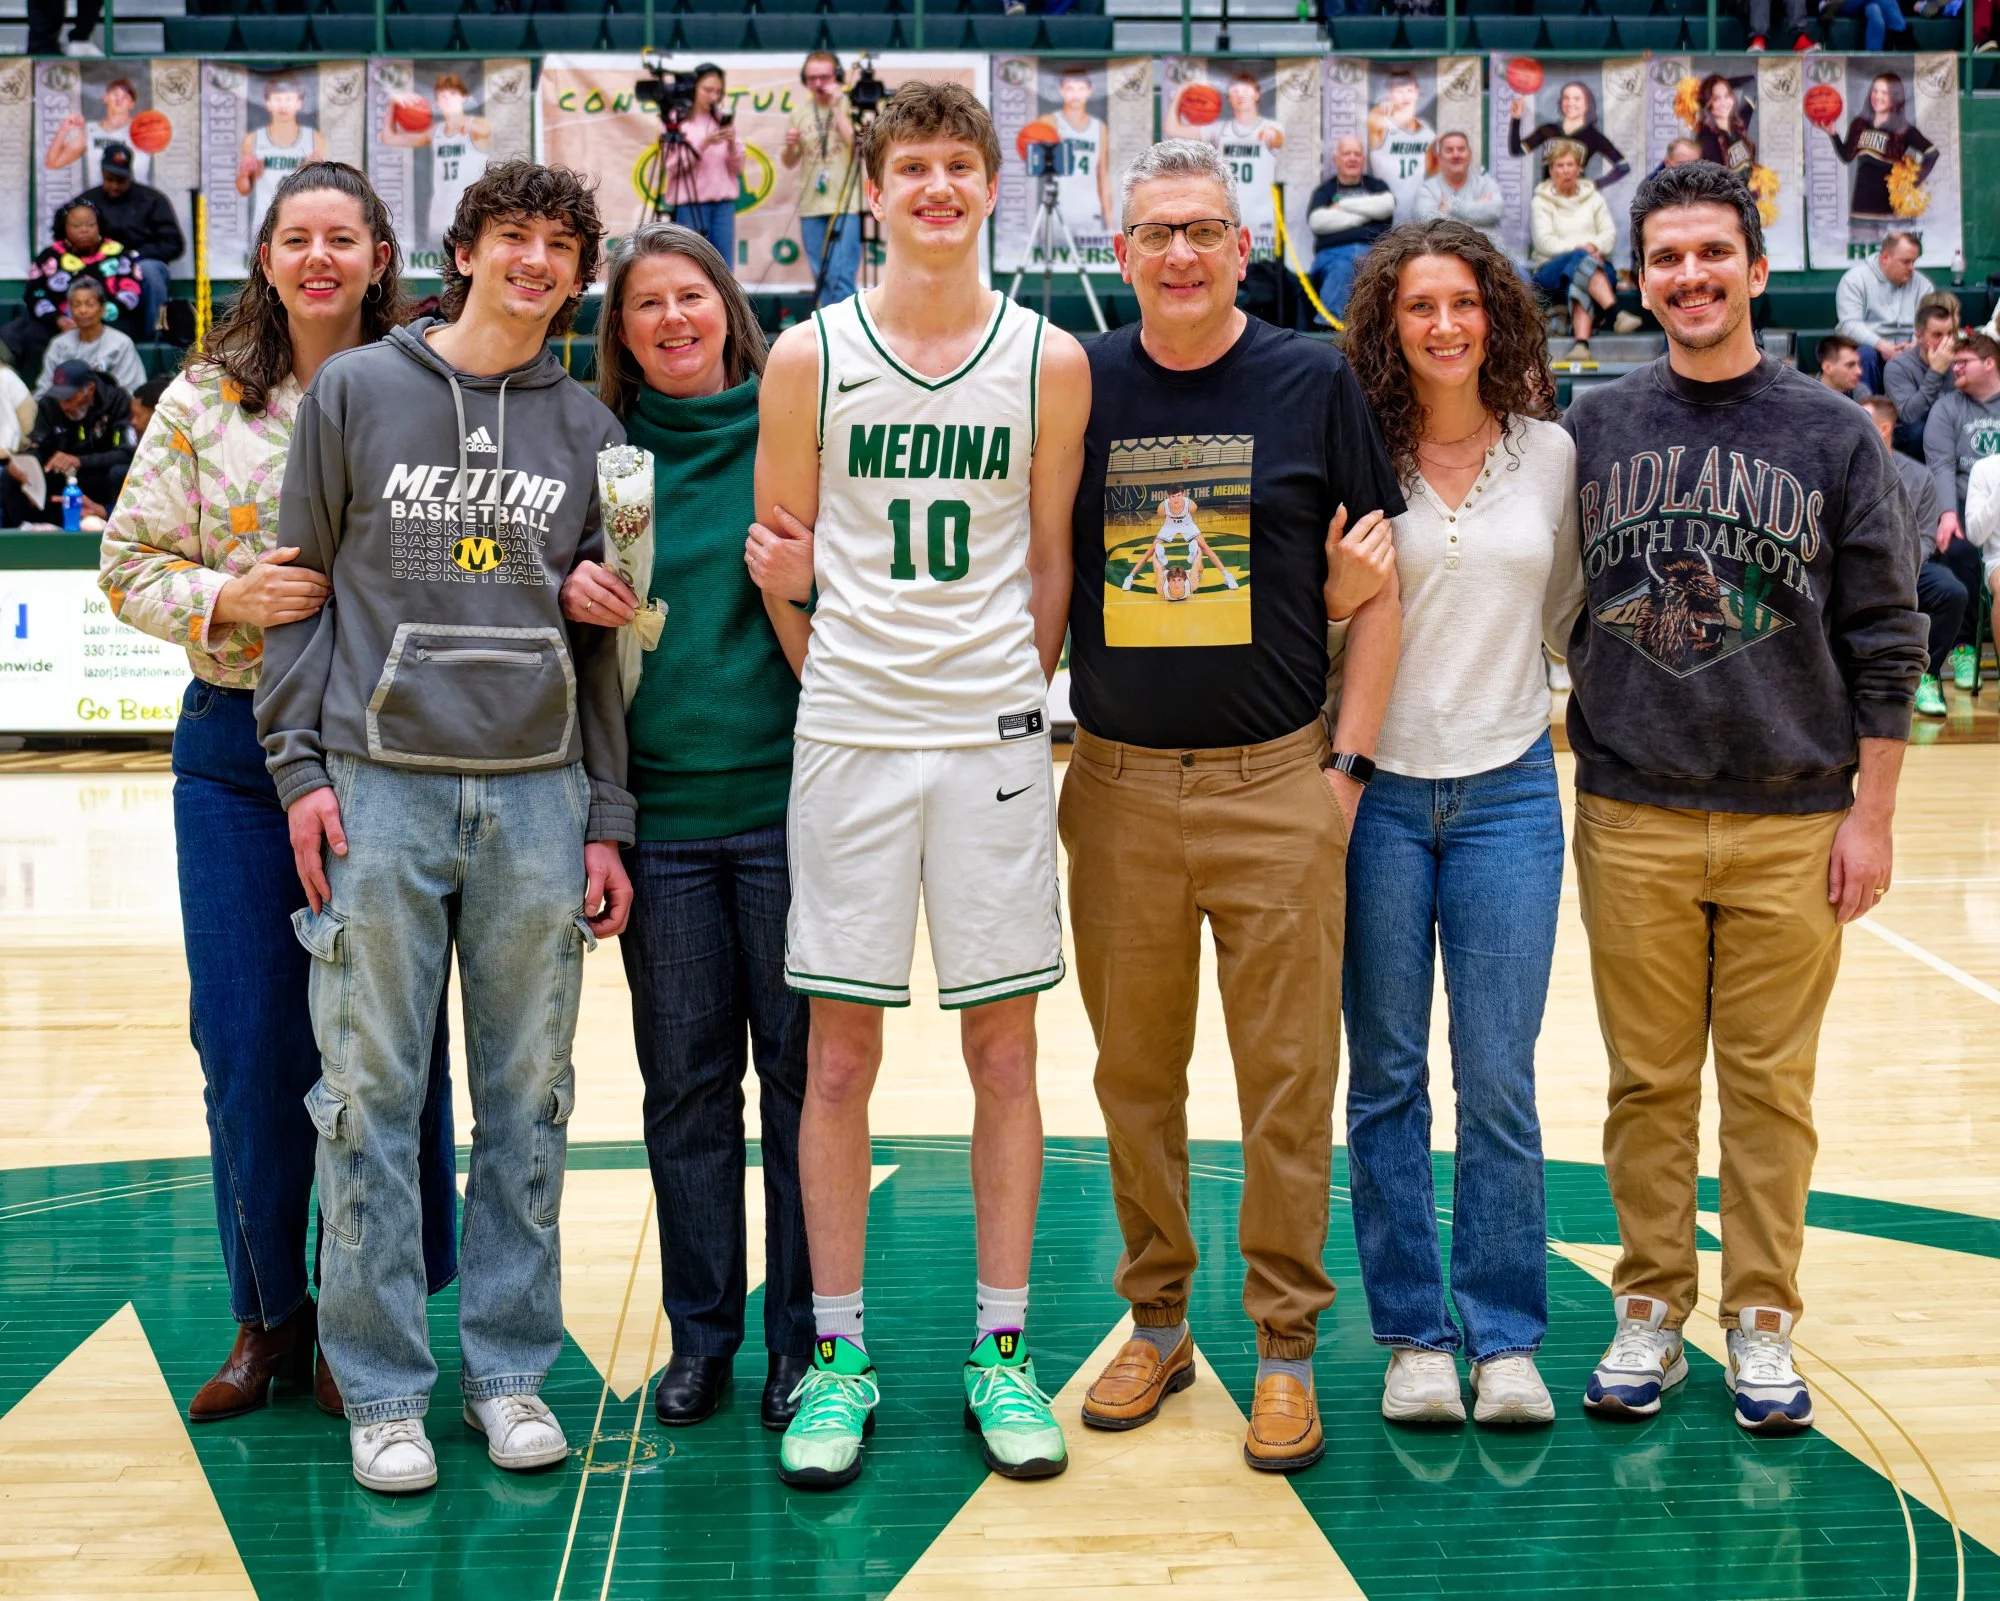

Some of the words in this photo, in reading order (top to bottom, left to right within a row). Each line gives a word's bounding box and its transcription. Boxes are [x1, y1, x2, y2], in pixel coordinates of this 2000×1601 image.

[849, 424, 1011, 480] MEDINA
[382, 463, 567, 514] MEDINA
[1194, 486, 1210, 499] THE
[1213, 484, 1250, 497] MEDINA
[1580, 446, 1824, 563] BADLANDS
[391, 500, 550, 532] BASKETBALL
[455, 538, 501, 571] M
[888, 498, 971, 582] 10
[1585, 519, 1675, 580] OUTH
[1683, 519, 1814, 602] DAKOTA
[83, 598, 106, 614] Joe
[77, 697, 112, 721] Go
[117, 696, 181, 721] Bees!
[1031, 717, 1038, 728] S
[820, 1340, 833, 1358] S
[1000, 1335, 1013, 1353] S
